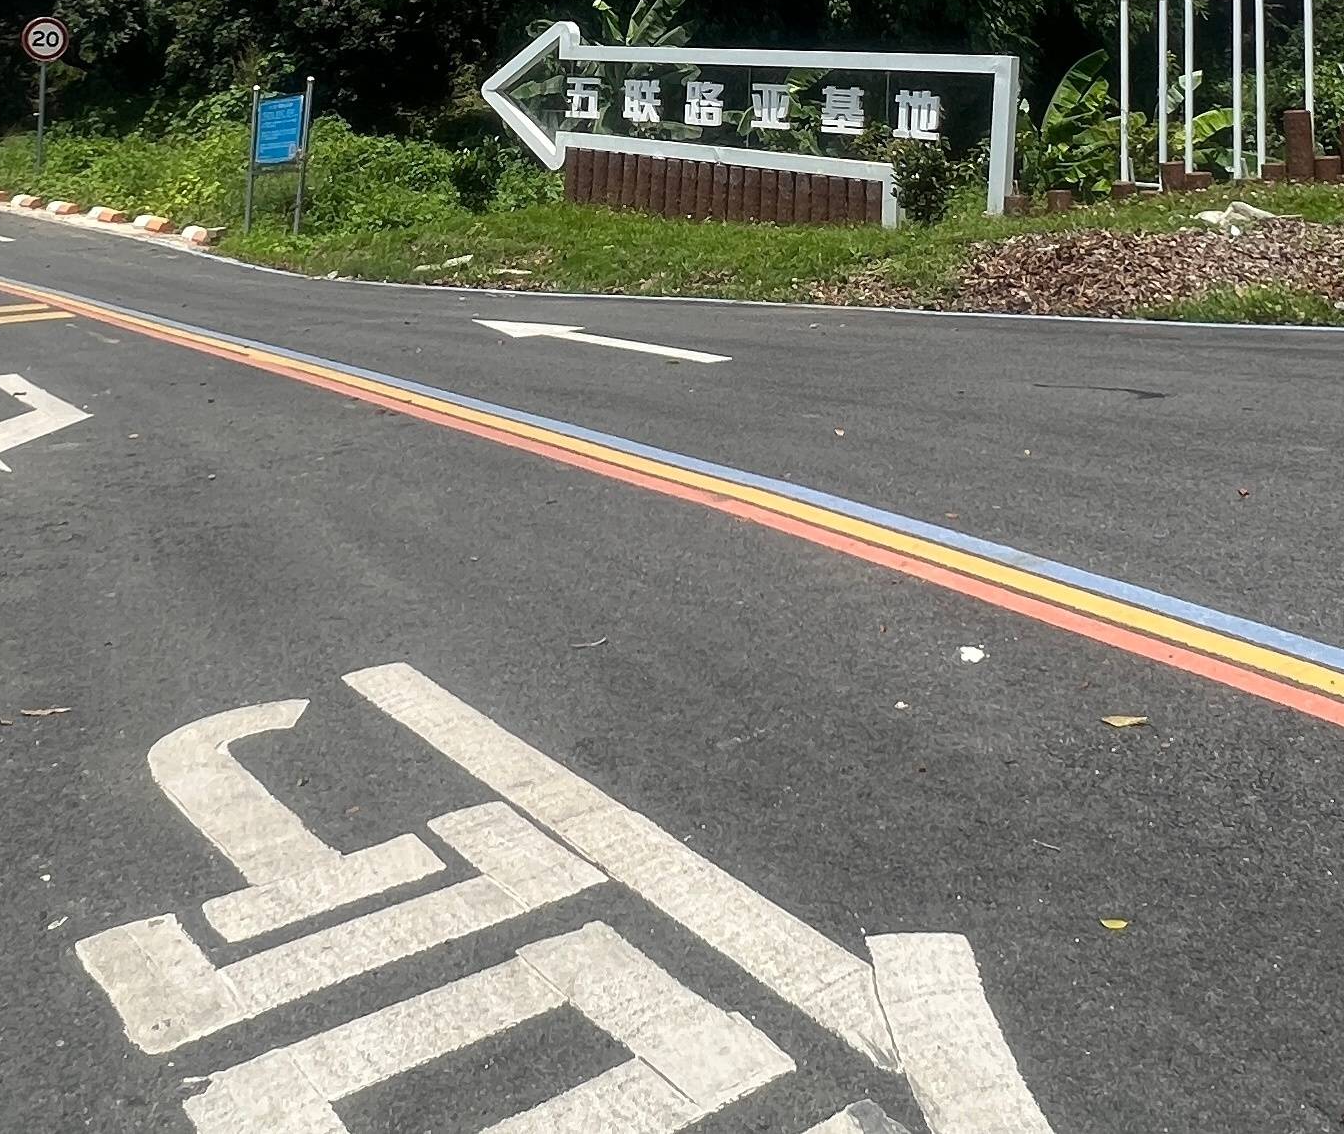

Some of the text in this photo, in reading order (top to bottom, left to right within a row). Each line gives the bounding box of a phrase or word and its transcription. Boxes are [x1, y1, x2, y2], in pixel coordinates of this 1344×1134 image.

[32, 30, 60, 48] 20
[564, 76, 942, 141] 五联路亚基地
